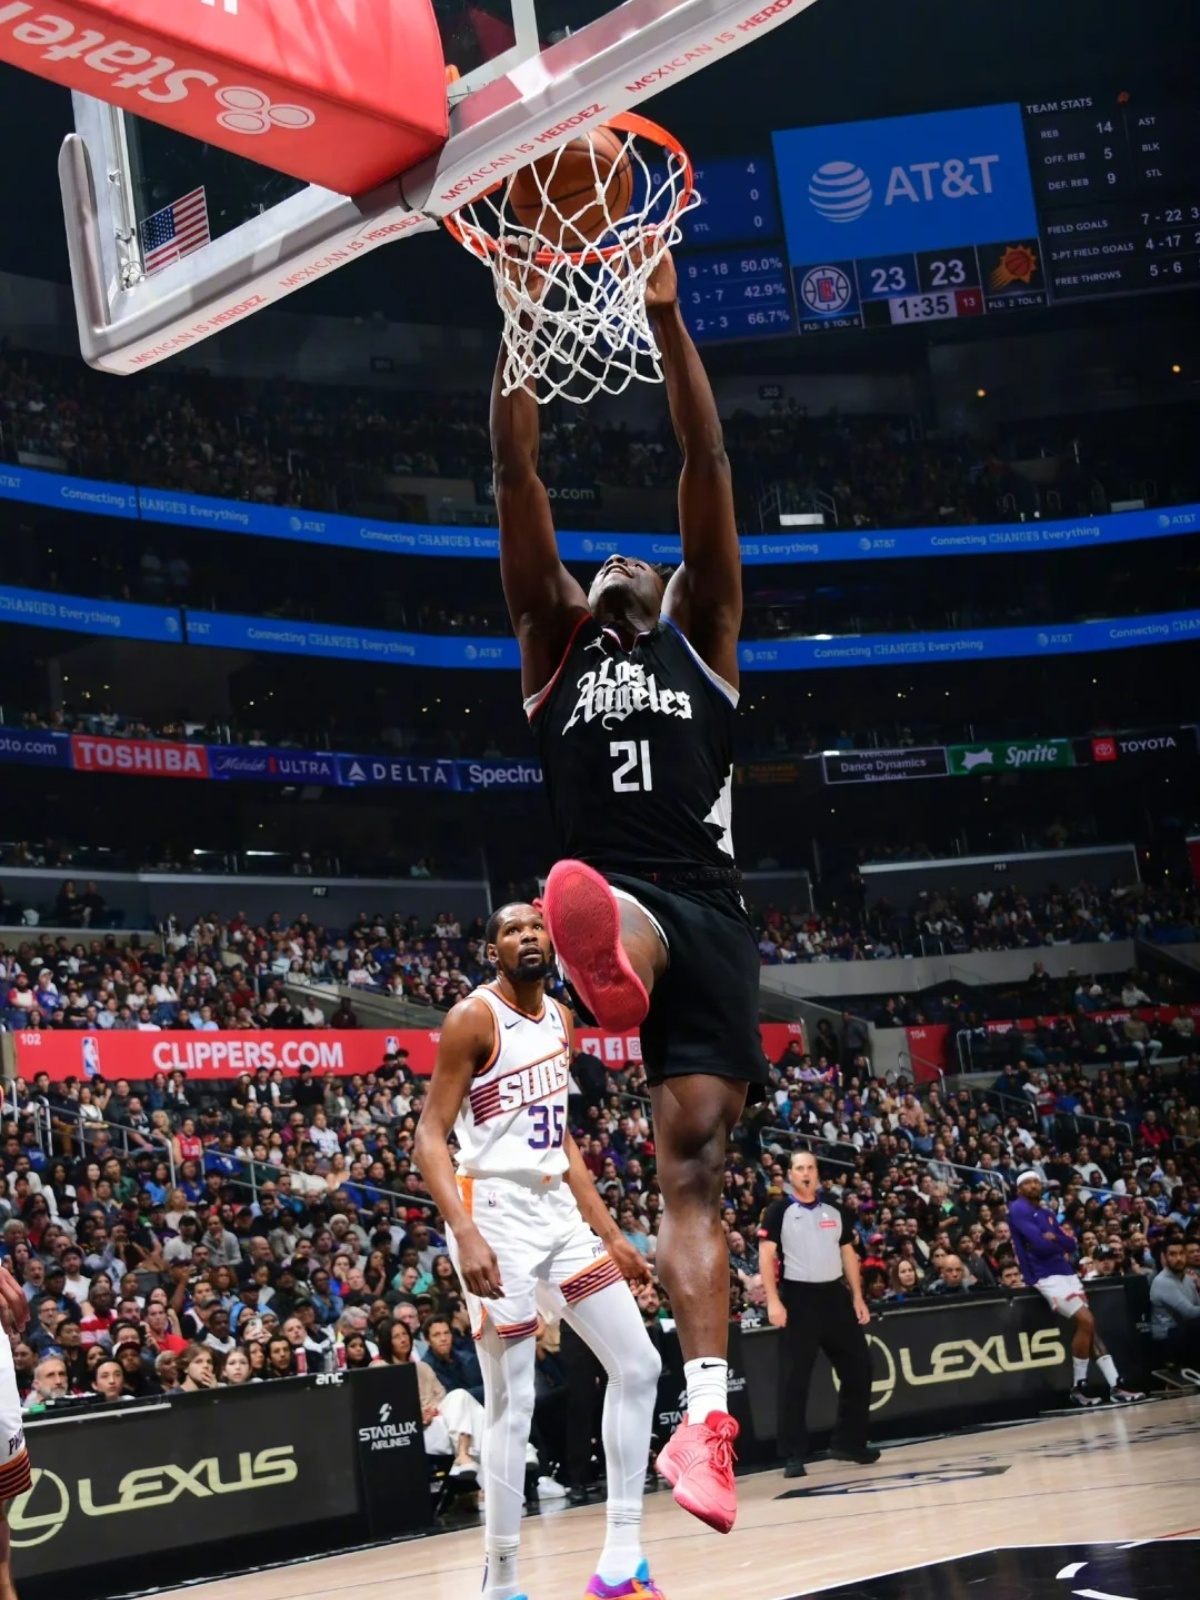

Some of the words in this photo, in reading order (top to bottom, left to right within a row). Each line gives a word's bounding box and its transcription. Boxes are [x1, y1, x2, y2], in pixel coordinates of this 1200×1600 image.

[714, 30, 736, 45] IS
[738, 0, 794, 32] HERD
[1026, 102, 1058, 114] TEAM
[1061, 98, 1092, 110] STATS
[515, 142, 534, 153] IS
[534, 103, 608, 144] HERDEZ
[1096, 121, 1113, 133] 14
[1138, 117, 1156, 126] AST
[1041, 130, 1059, 139] REB
[1104, 148, 1112, 159] 5
[1142, 143, 1160, 152] BLK
[1044, 155, 1065, 165] OFF.
[1067, 152, 1086, 162] REB
[747, 163, 756, 175] 4
[1146, 169, 1163, 178] STL
[884, 154, 999, 206] AT&T
[1048, 181, 1068, 190] DEF.
[1071, 178, 1089, 187] REB
[1107, 173, 1116, 184] 9
[750, 189, 759, 201] 0
[754, 215, 763, 227] 0
[1141, 213, 1149, 225] 7
[1165, 209, 1182, 222] 22
[346, 240, 364, 252] IS
[362, 215, 426, 242] HERDEZ
[1047, 224, 1074, 234] FIELD
[1076, 220, 1108, 231] GOALS
[1145, 238, 1154, 249] 4
[1051, 252, 1071, 261] 3-PT
[1074, 247, 1100, 257] FIELD
[1102, 243, 1134, 254] GOALS
[688, 266, 697, 278] 9
[712, 263, 728, 276] 18
[740, 258, 783, 273] 50.0%
[929, 259, 966, 286] 23
[1150, 265, 1158, 276] 5
[1173, 261, 1182, 273] 6
[870, 266, 907, 293] 23
[1055, 276, 1079, 286] FREE
[1081, 270, 1122, 283] THROWS
[692, 292, 700, 304] 3
[715, 289, 724, 301] 7
[744, 283, 786, 298] 42.9%
[897, 295, 950, 319] 1:35
[962, 297, 976, 308] 13
[192, 323, 210, 335] IS
[208, 294, 267, 326] HERDEZ
[696, 319, 705, 331] 2
[720, 316, 728, 328] 3
[748, 310, 790, 325] 66.7%
[547, 486, 595, 499] o.com
[60, 486, 125, 508] Connecting
[190, 506, 249, 525] Everything
[303, 520, 326, 532] AT&T
[1172, 513, 1196, 525] AT&T
[359, 528, 415, 546] Connecting
[417, 534, 471, 547] CHANGES
[473, 536, 500, 551] Every
[873, 538, 896, 549] AT&T
[930, 535, 987, 548] Connecting
[989, 531, 1040, 544] CHANGES
[1042, 525, 1100, 541] Everything
[762, 542, 819, 556] Everything
[59, 605, 121, 627] Everything
[1050, 633, 1073, 643] AT&T
[1110, 624, 1170, 639] Connecting
[247, 627, 306, 646] Connecting
[308, 634, 360, 650] CHANGES
[362, 639, 416, 656] Everything
[814, 646, 871, 659] Connecting
[874, 641, 926, 655] CHANGES
[928, 639, 983, 653] Everything
[479, 648, 502, 658] AT&T
[755, 651, 778, 661] AT&T
[594, 657, 647, 688] Los
[562, 671, 692, 735] Angeles
[1120, 737, 1176, 753] TOYOTA
[78, 741, 203, 772] TOSHIBA
[1005, 743, 1058, 767] Sprite
[279, 759, 331, 776] ULTRA
[609, 739, 653, 793] 21
[841, 761, 873, 773] Dance
[876, 757, 927, 771] Dynamics
[372, 763, 448, 784] DELTA
[469, 764, 544, 788] Spectru
[20, 1033, 42, 1045] 102
[152, 1041, 344, 1070] CLIPPERS.COM
[499, 1055, 570, 1111] SUNS
[528, 1105, 564, 1149] 35
[899, 1328, 1065, 1386] LEXUS
[315, 1372, 344, 1385] anc
[359, 1421, 418, 1441] STARLUX
[371, 1436, 411, 1450] AIRLINES
[78, 1445, 298, 1516] LEXUS
